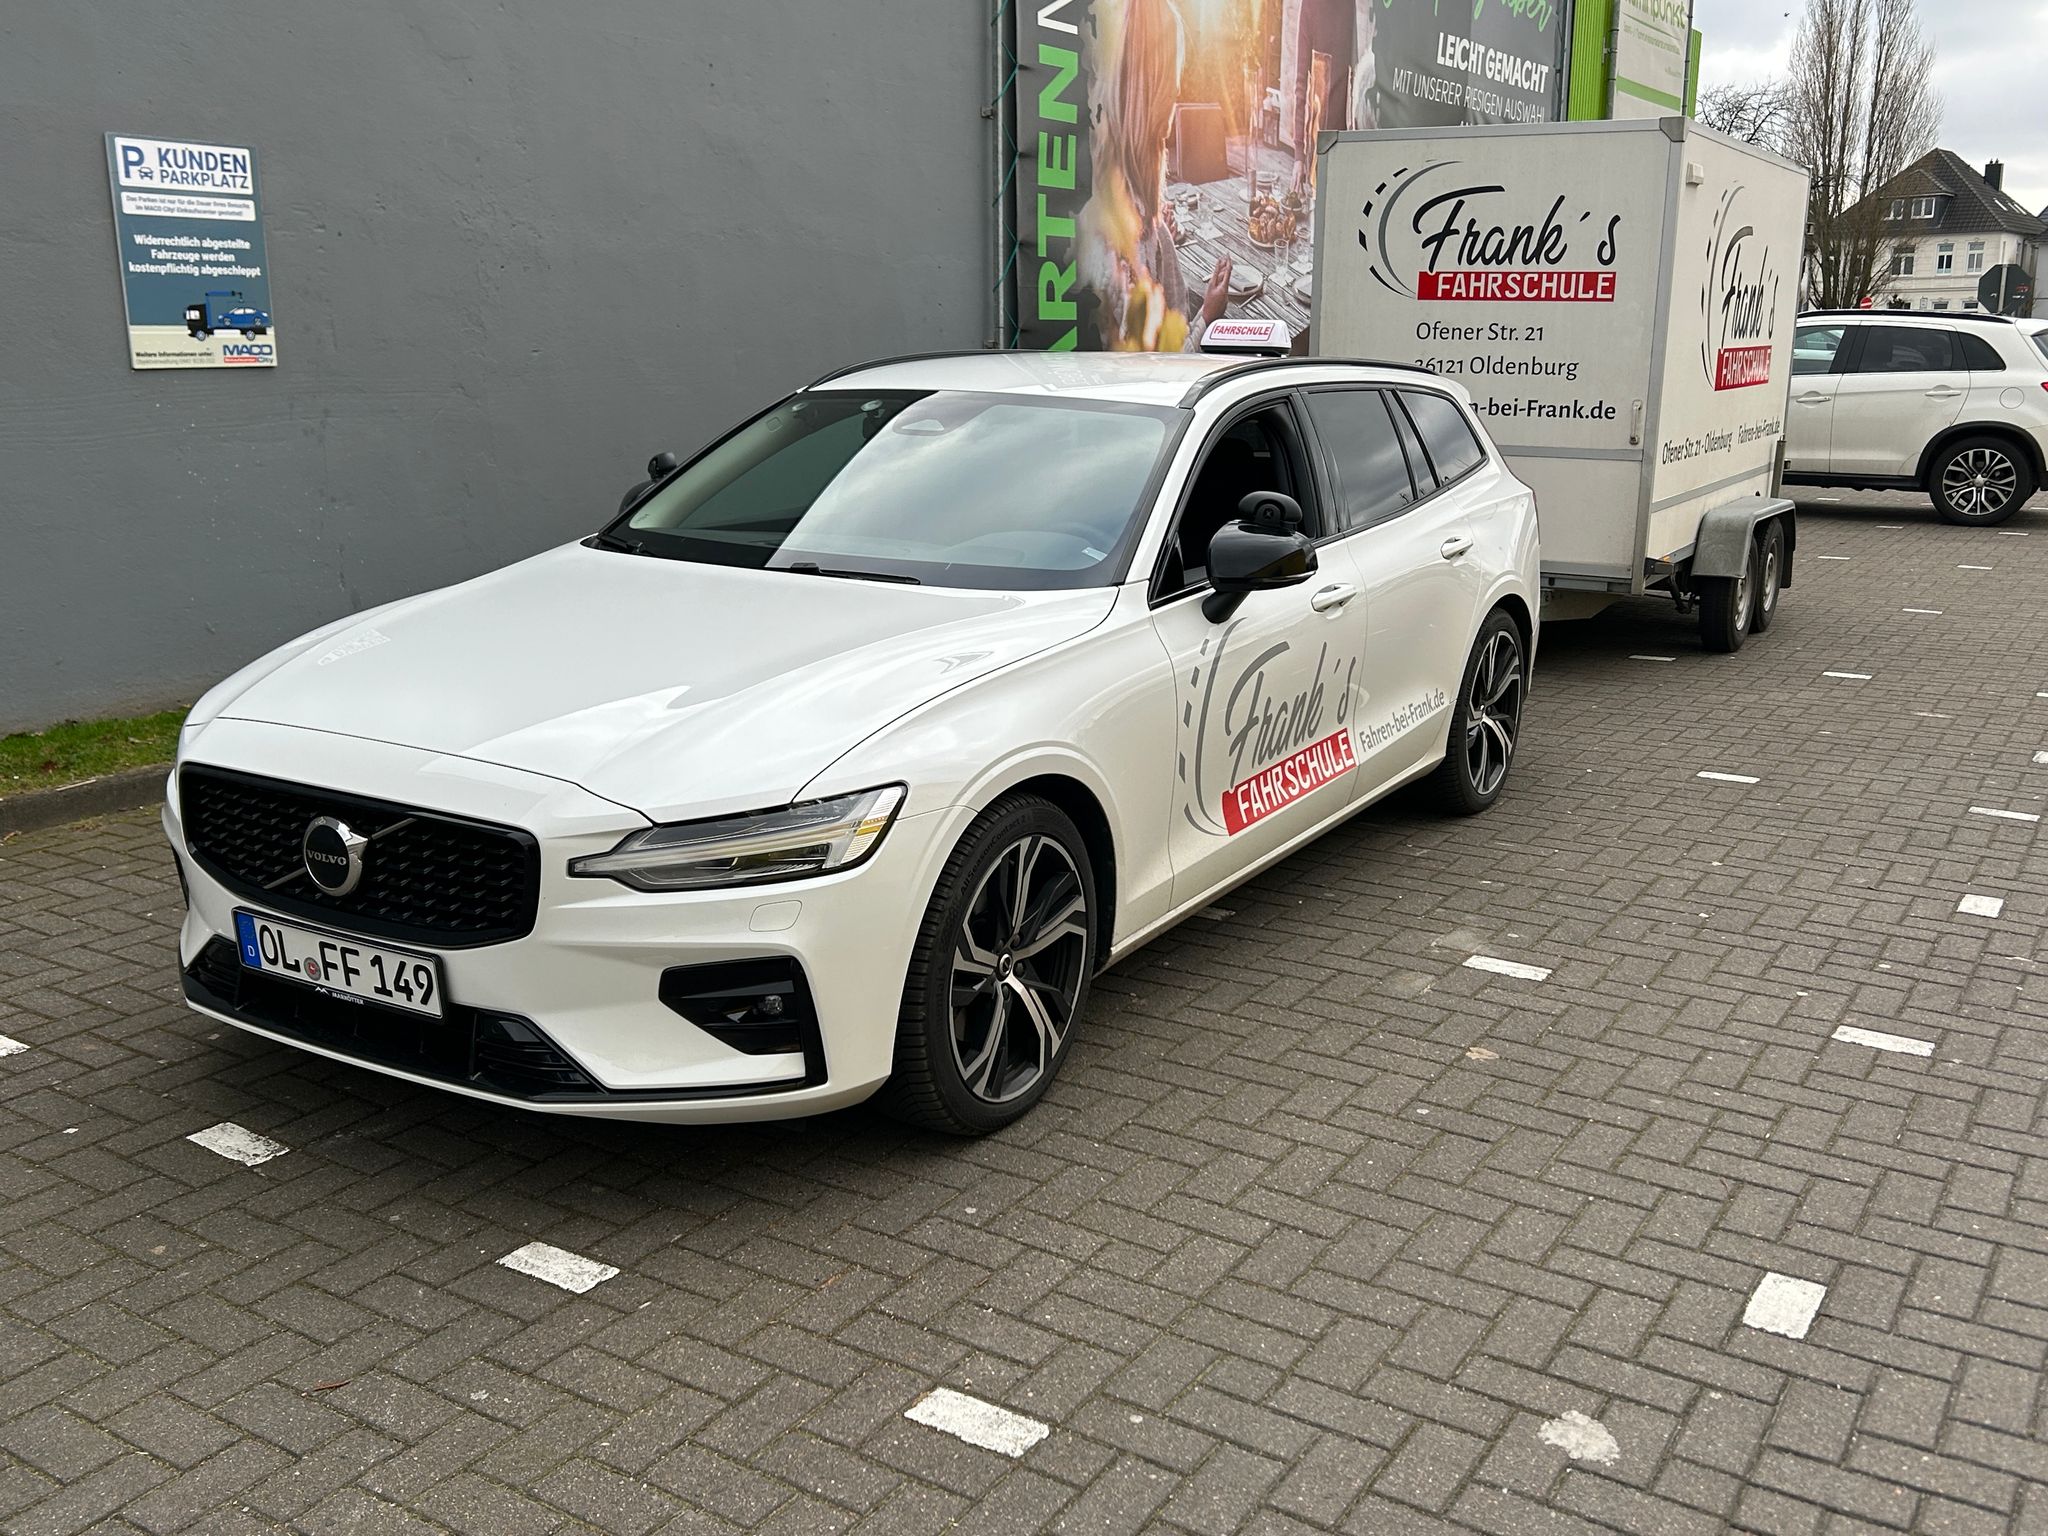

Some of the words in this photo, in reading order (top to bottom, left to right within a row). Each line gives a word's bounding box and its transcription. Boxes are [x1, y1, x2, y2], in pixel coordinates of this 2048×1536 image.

[1436, 32, 1485, 75] LEICHT
[1485, 48, 1549, 93] GEMACHT
[1392, 68, 1412, 95] MIT
[1413, 71, 1463, 106] UNSERER
[1463, 86, 1502, 117] RIESIGEN
[121, 145, 145, 179] P
[157, 147, 248, 174] KUNDEN
[160, 169, 250, 189] PARKPLATZ
[133, 234, 200, 248] Widerrechtlich
[201, 237, 251, 250] abgestellte
[150, 249, 200, 262] Fahrzeuge
[201, 251, 236, 262] werden
[128, 261, 200, 276] kostenpflichtig
[200, 265, 261, 278] abgeschleppt
[1437, 273, 1614, 299] FAHRSCHULE
[1213, 325, 1271, 336] FAHRSCHULE
[1416, 321, 1484, 341] Ofener
[1487, 323, 1519, 341] Str.
[1524, 326, 1544, 341] 21
[1469, 355, 1580, 381] Oldenburg
[1720, 347, 1772, 387] FAHRSCHULE
[1662, 440, 1684, 464] Ofener
[1694, 439, 1702, 456] 21
[1705, 428, 1733, 453] Oldenburg
[1738, 416, 1781, 444] Fahren-bei-Frank.de
[1359, 688, 1445, 752] Fahren-bei-Frank.de
[1237, 730, 1355, 824] FAHRSCHULE
[306, 849, 348, 866] VOLVO
[247, 945, 256, 958] D
[258, 924, 301, 973] OL
[318, 940, 361, 987] FF
[369, 954, 434, 1006] 149
